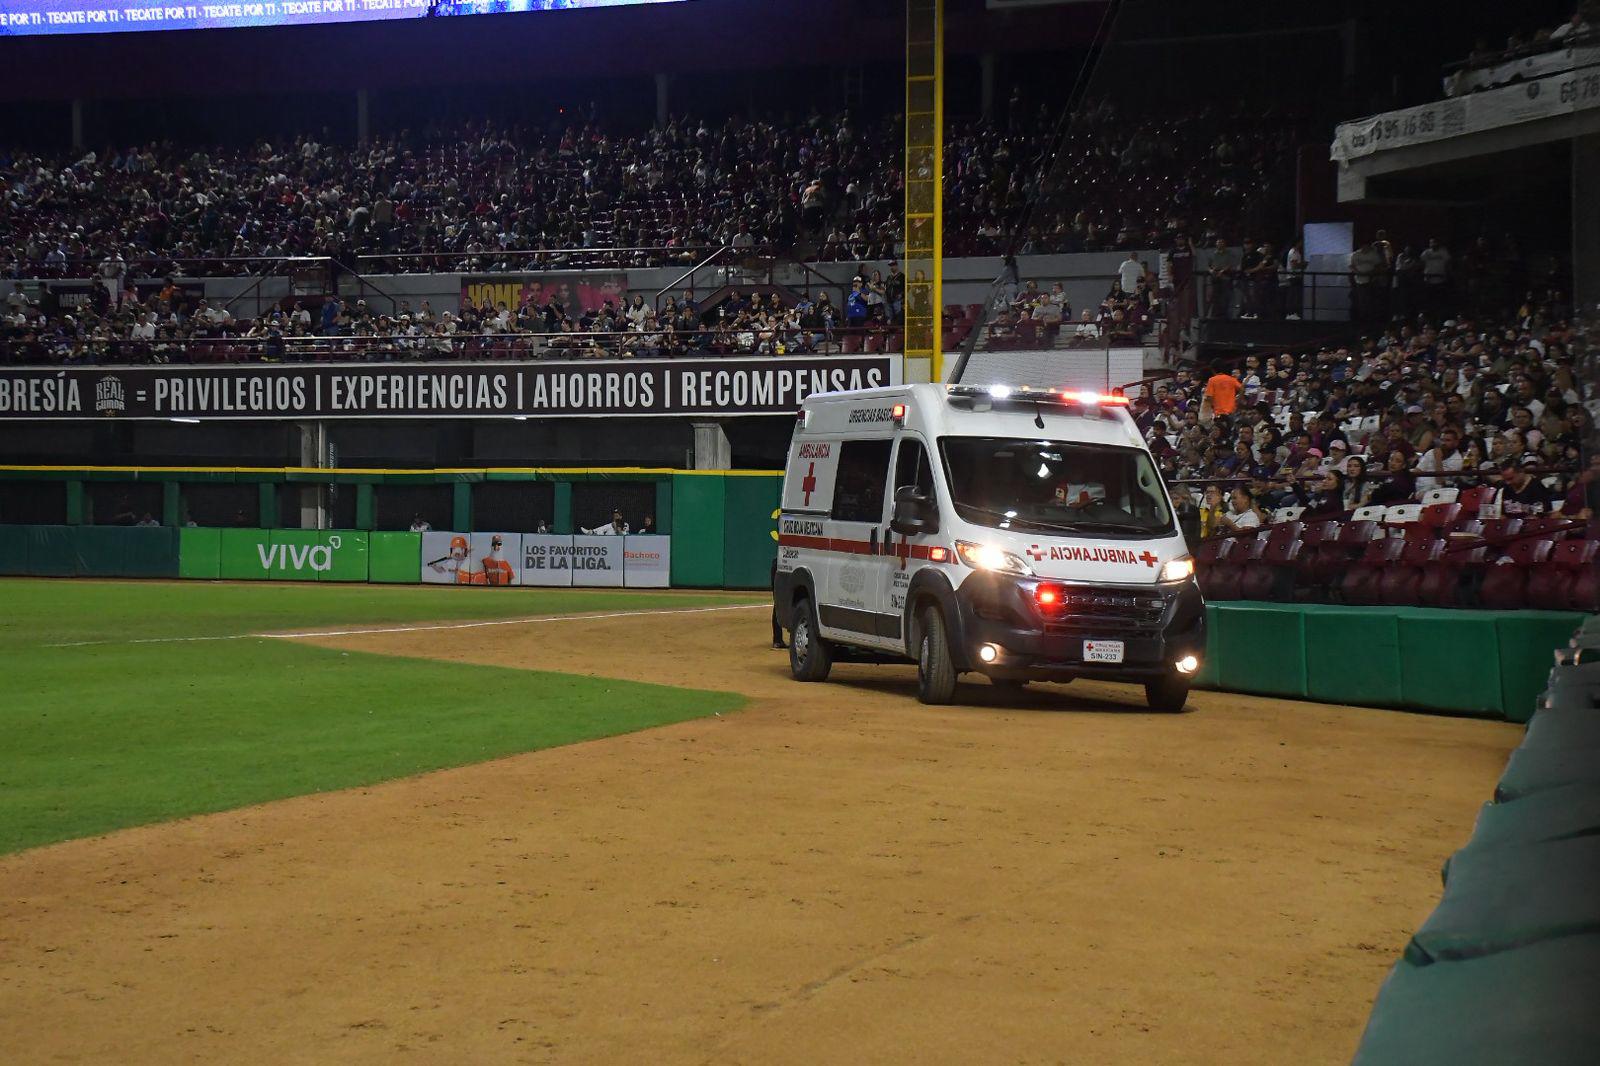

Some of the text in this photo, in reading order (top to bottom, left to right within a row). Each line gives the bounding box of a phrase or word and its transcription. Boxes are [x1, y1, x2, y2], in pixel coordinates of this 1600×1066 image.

[10, 13, 29, 25] POR
[31, 13, 41, 24] TI
[46, 11, 85, 24] TECATE
[87, 11, 107, 23] POR
[109, 10, 119, 22] TI
[124, 9, 163, 21] TECATE
[165, 8, 185, 20] POR
[187, 7, 197, 19] TI
[202, 6, 242, 18] TECATE
[243, 4, 263, 16] POR
[265, 3, 276, 15] TI
[282, 2, 321, 14] TECATE
[323, 0, 343, 13] POR
[345, 0, 356, 12] TI
[0, 371, 81, 411] BRESÍA
[96, 377, 125, 401] REAL
[155, 376, 306, 411] PRIVILEGIOS
[331, 374, 508, 410] EXPERIENCIAS
[534, 373, 655, 408] AHORROS
[681, 369, 882, 406] RECOMPENSAS
[526, 545, 608, 556] LOS FAVORITOS
[525, 557, 611, 571] DE LA LIGA.
[1090, 652, 1117, 661] SIN-233
